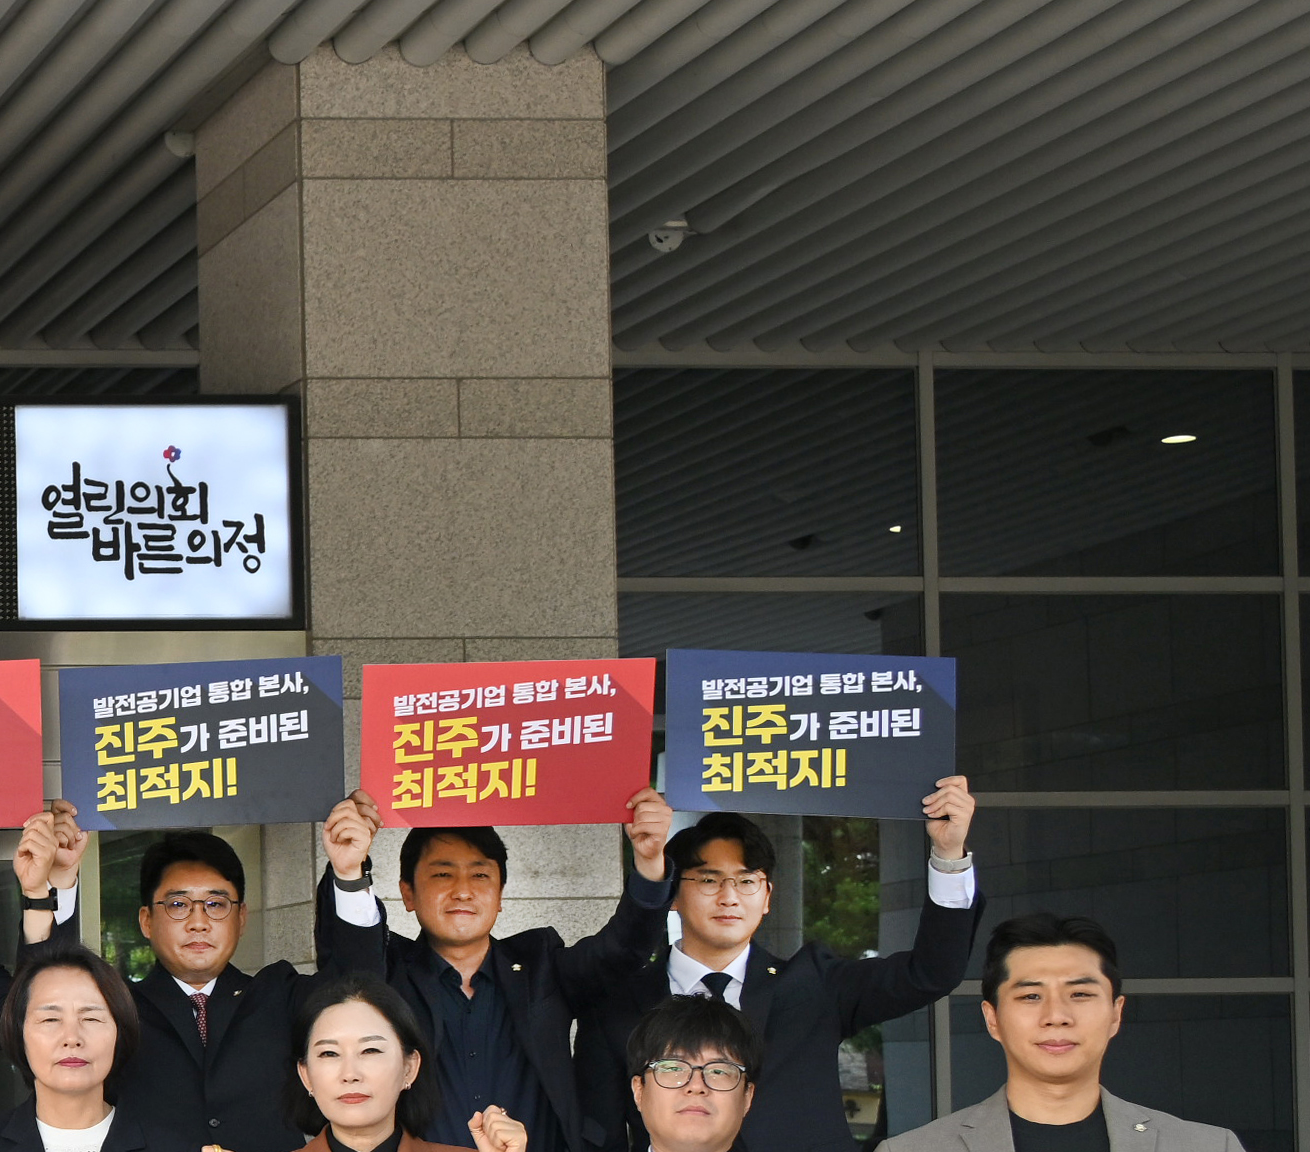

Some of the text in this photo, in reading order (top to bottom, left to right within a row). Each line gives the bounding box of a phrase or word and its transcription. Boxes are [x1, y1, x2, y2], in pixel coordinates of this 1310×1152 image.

[42, 461, 208, 539] 열린의회
[92, 513, 265, 580] 바른의정
[94, 672, 308, 719] 발전공기업 통합 본사,
[394, 674, 616, 716] 발전공기업 통합 본사,
[702, 670, 921, 700] 발전공기업 통합 본사,
[95, 710, 308, 765] 진주가 준비된
[393, 713, 612, 763] 진주가 준비된
[702, 704, 920, 746] 진주가 준비된
[97, 756, 237, 811] 최적지!
[392, 758, 536, 809] 최적지!
[702, 748, 845, 792] 최적지!
